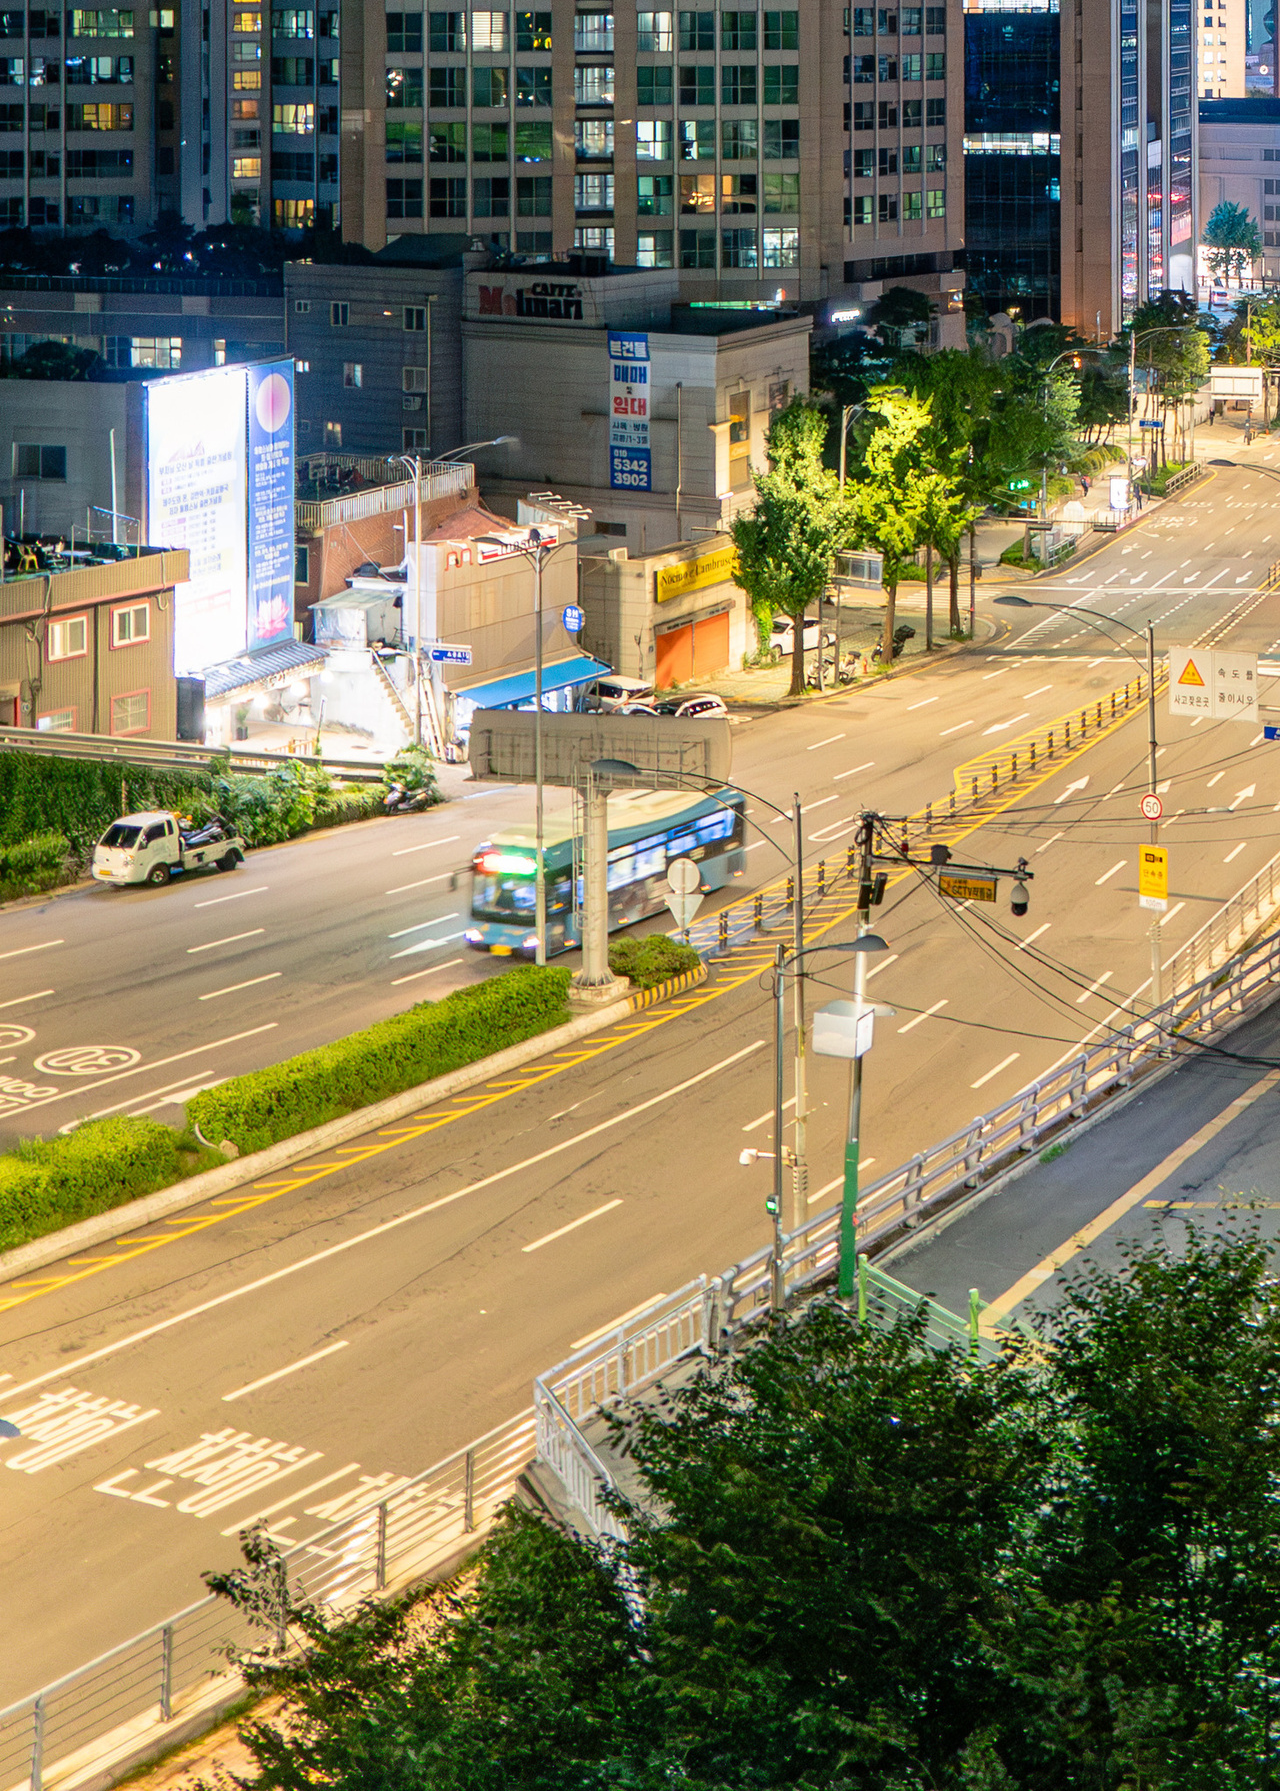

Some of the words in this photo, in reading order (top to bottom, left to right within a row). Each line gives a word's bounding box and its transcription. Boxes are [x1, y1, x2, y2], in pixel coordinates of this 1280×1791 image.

[613, 364, 647, 383] 매매
[613, 396, 647, 416] 임대
[613, 449, 628, 458] 010
[613, 459, 648, 472] 5342
[613, 473, 648, 486] 3902
[695, 558, 732, 576] Lambrusc
[1174, 694, 1210, 708] 사고잦은곳
[1218, 692, 1254, 705] 줄이시오
[1145, 801, 1159, 813] 50
[93, 1428, 325, 1518] 천천히
